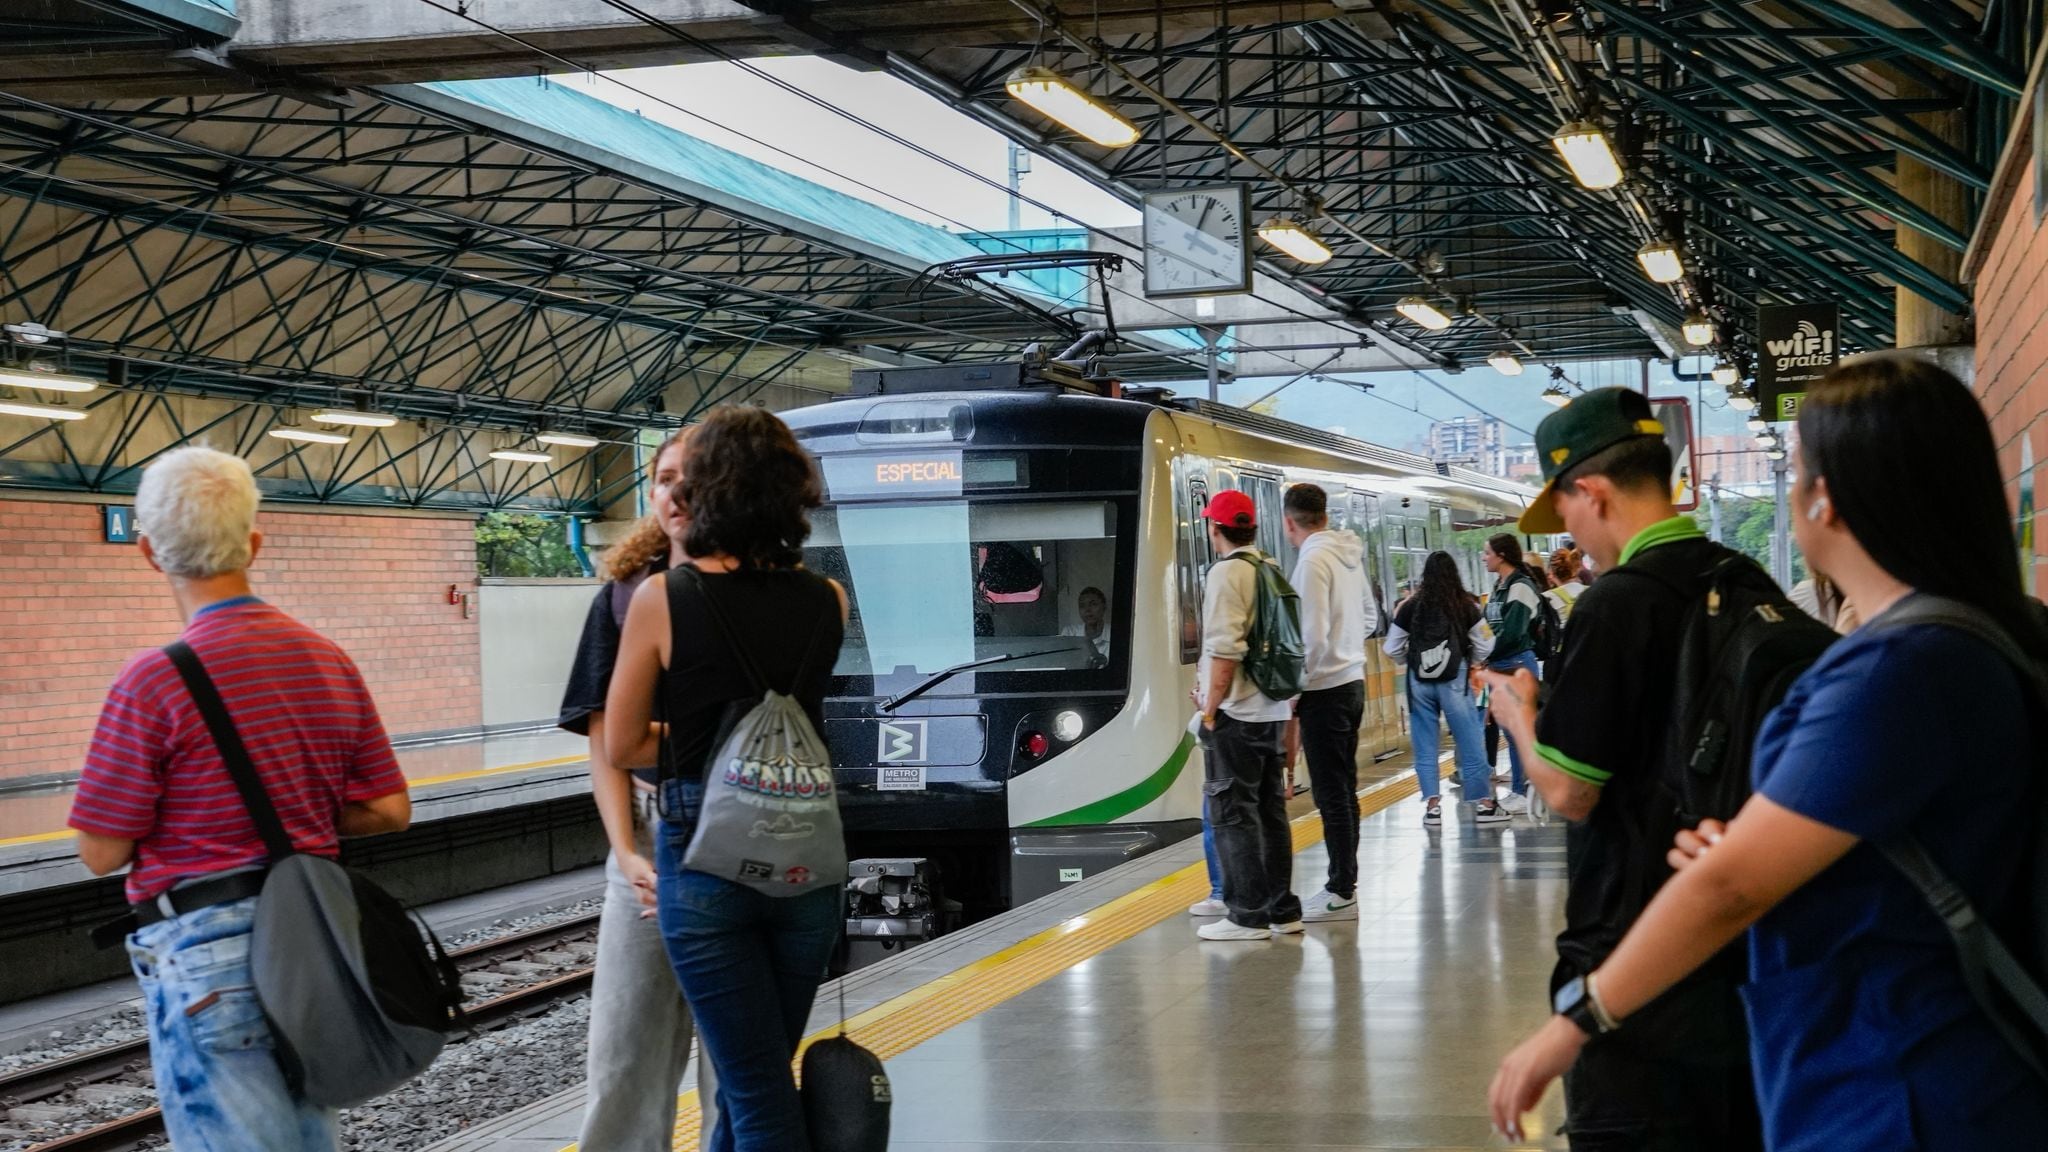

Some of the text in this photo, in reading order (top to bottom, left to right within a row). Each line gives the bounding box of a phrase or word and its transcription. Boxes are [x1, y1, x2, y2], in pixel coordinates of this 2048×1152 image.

[1776, 351, 1833, 371] gratis
[877, 462, 961, 482] ESPECIAL
[111, 513, 124, 535] A
